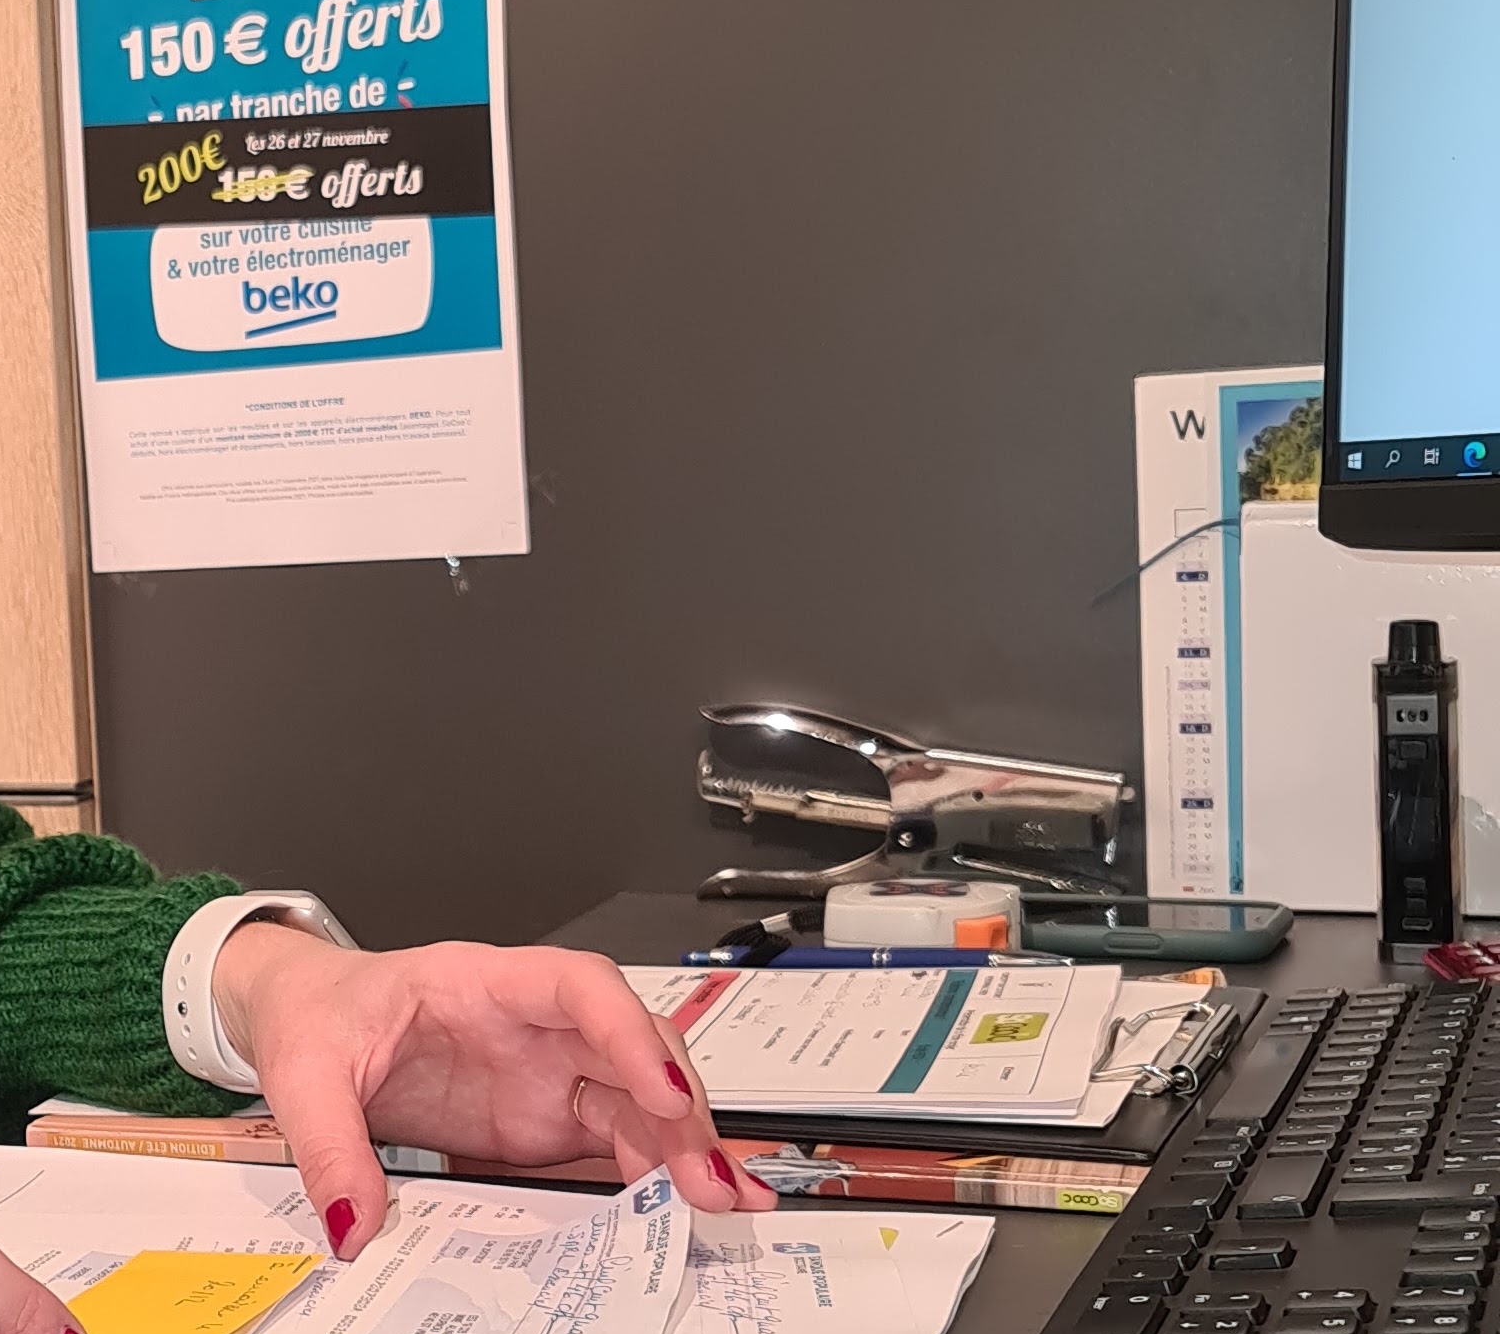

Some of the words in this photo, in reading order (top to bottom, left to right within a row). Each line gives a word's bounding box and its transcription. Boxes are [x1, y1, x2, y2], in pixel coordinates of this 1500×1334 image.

[120, 18, 215, 81] 150
[224, 14, 267, 64] €
[231, 81, 341, 120] tranche
[350, 75, 385, 108] de
[245, 133, 265, 154] Les
[267, 133, 286, 152] 26
[288, 133, 301, 149] et
[303, 131, 321, 149] 27
[322, 127, 389, 148] novembre
[321, 159, 423, 208] offerts
[200, 230, 232, 250] sur
[238, 223, 291, 245] votre
[298, 219, 372, 240] cuisine
[167, 259, 182, 279] &
[188, 255, 240, 278] votre
[246, 237, 410, 274] électroménager
[242, 276, 339, 314] beko
[53, 1137, 76, 1147] 2021
[83, 1138, 136, 1150] AUTOMNE
